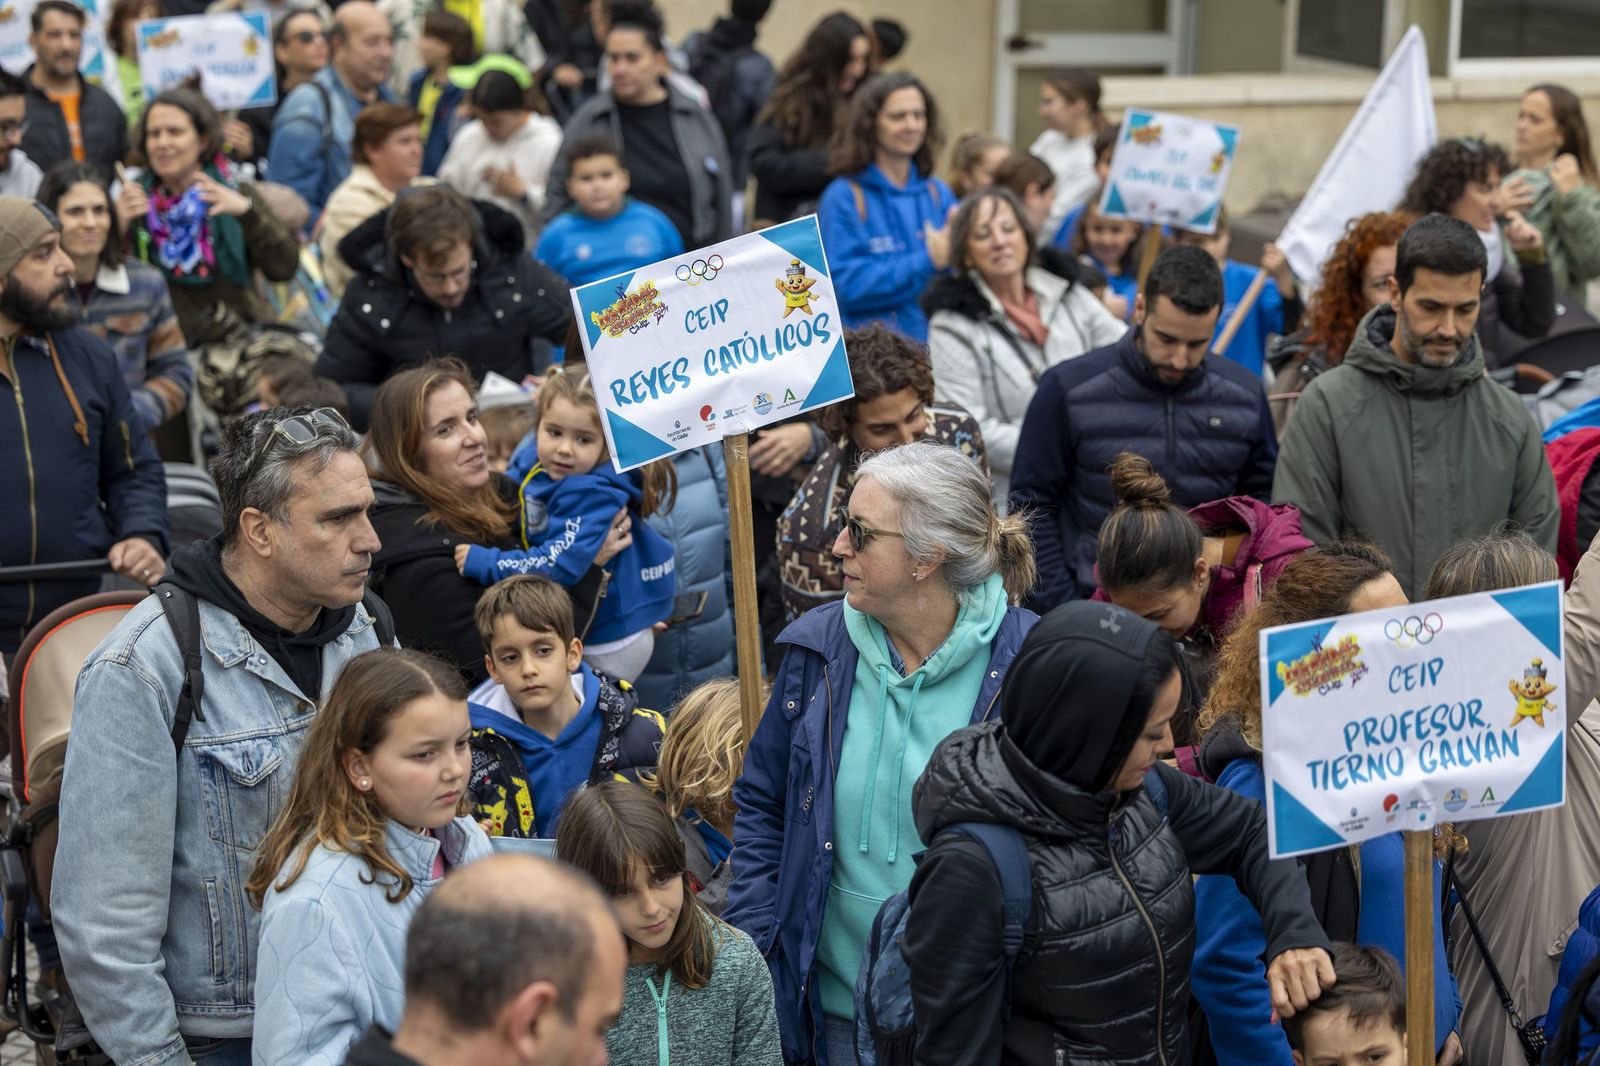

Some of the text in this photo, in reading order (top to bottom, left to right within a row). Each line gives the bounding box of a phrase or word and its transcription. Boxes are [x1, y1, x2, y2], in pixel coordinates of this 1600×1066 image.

[684, 297, 730, 335] CEIP
[609, 356, 691, 407] REYES
[703, 311, 831, 377] CATÓLICOS
[641, 563, 664, 582] CEIP
[1388, 657, 1445, 693] CEIP
[1343, 698, 1487, 753] PROFESOR
[1306, 723, 1521, 791] TIERNO GALVÁN
